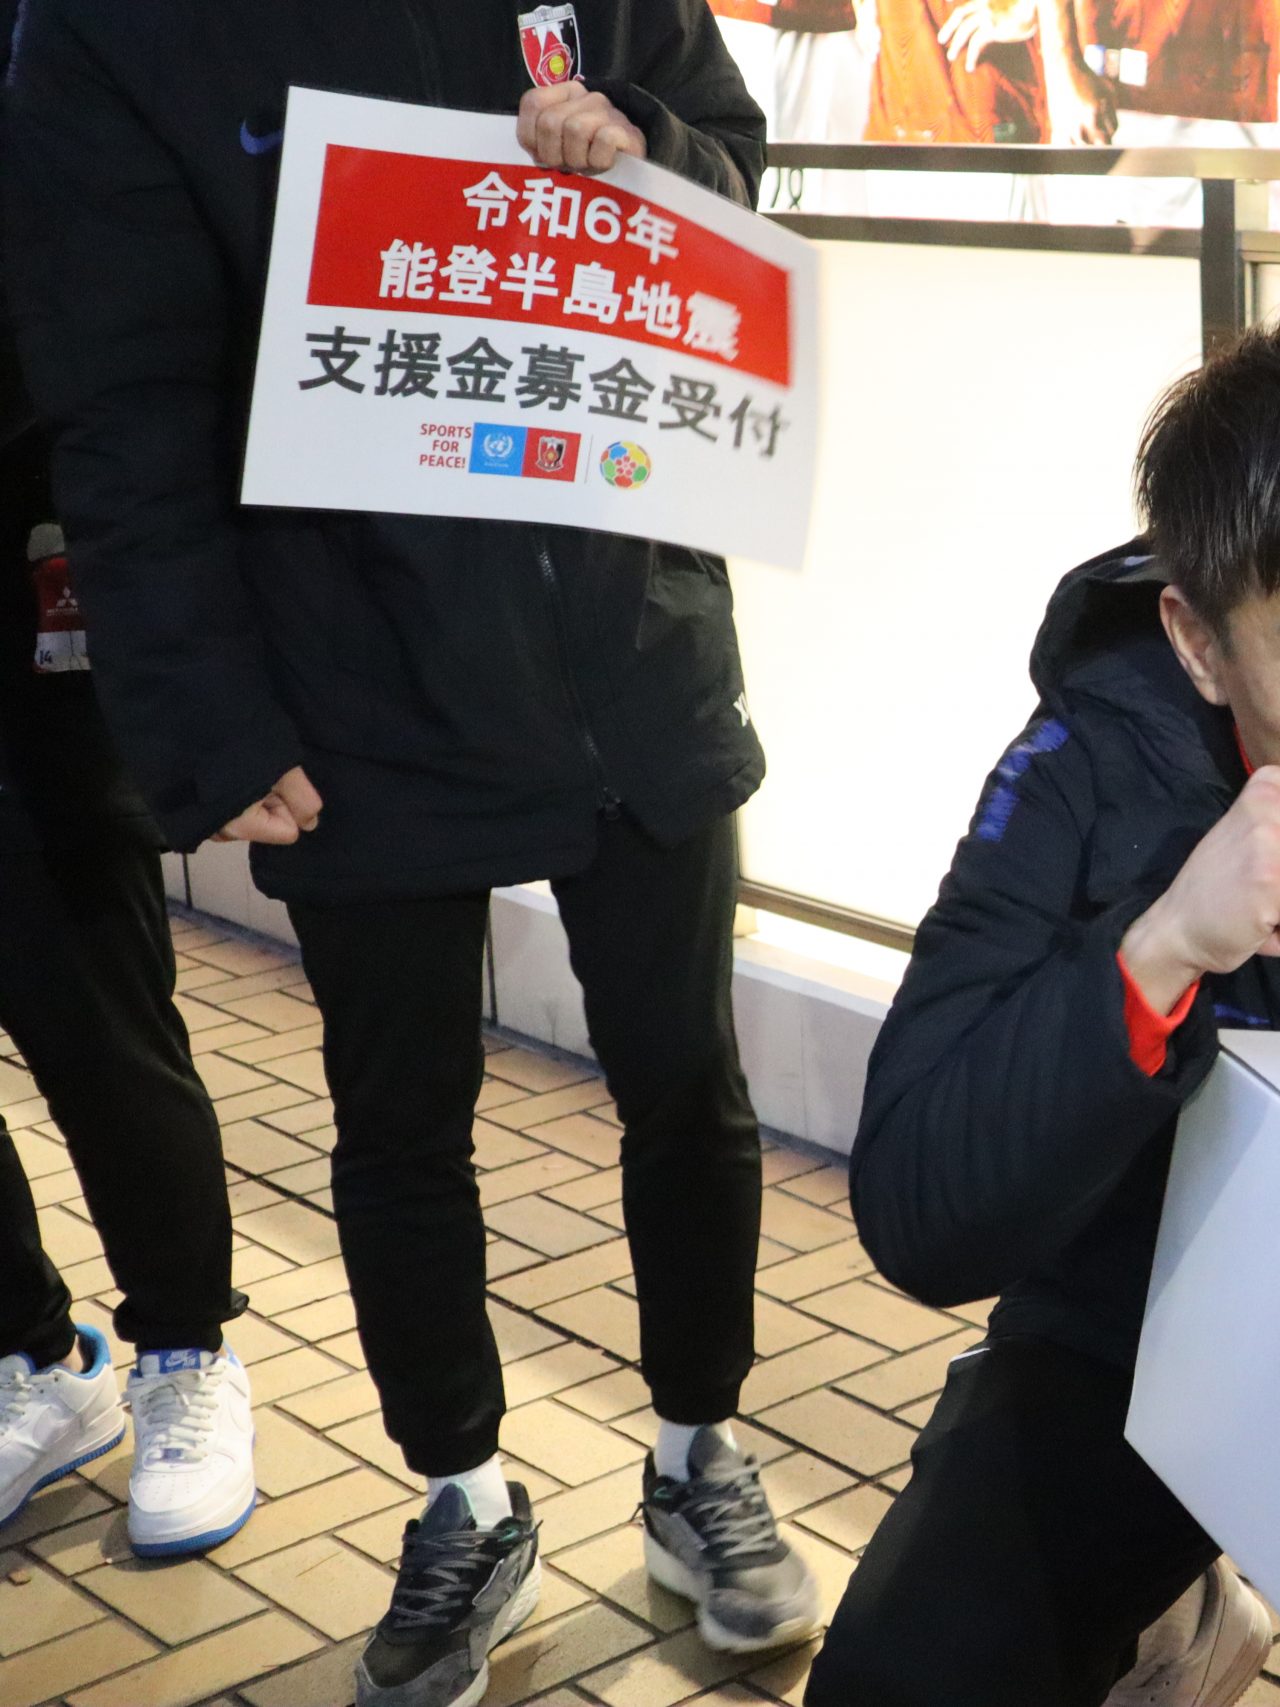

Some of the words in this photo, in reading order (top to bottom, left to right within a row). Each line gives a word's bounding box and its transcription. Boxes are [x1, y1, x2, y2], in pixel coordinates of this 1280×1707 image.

[463, 171, 679, 264] 令和6年
[378, 238, 742, 362] 能登半島地震
[298, 325, 791, 462] 支援金募金受付
[420, 423, 472, 438] SPORTS
[432, 440, 459, 452] FOR
[419, 454, 466, 468] PEACE!
